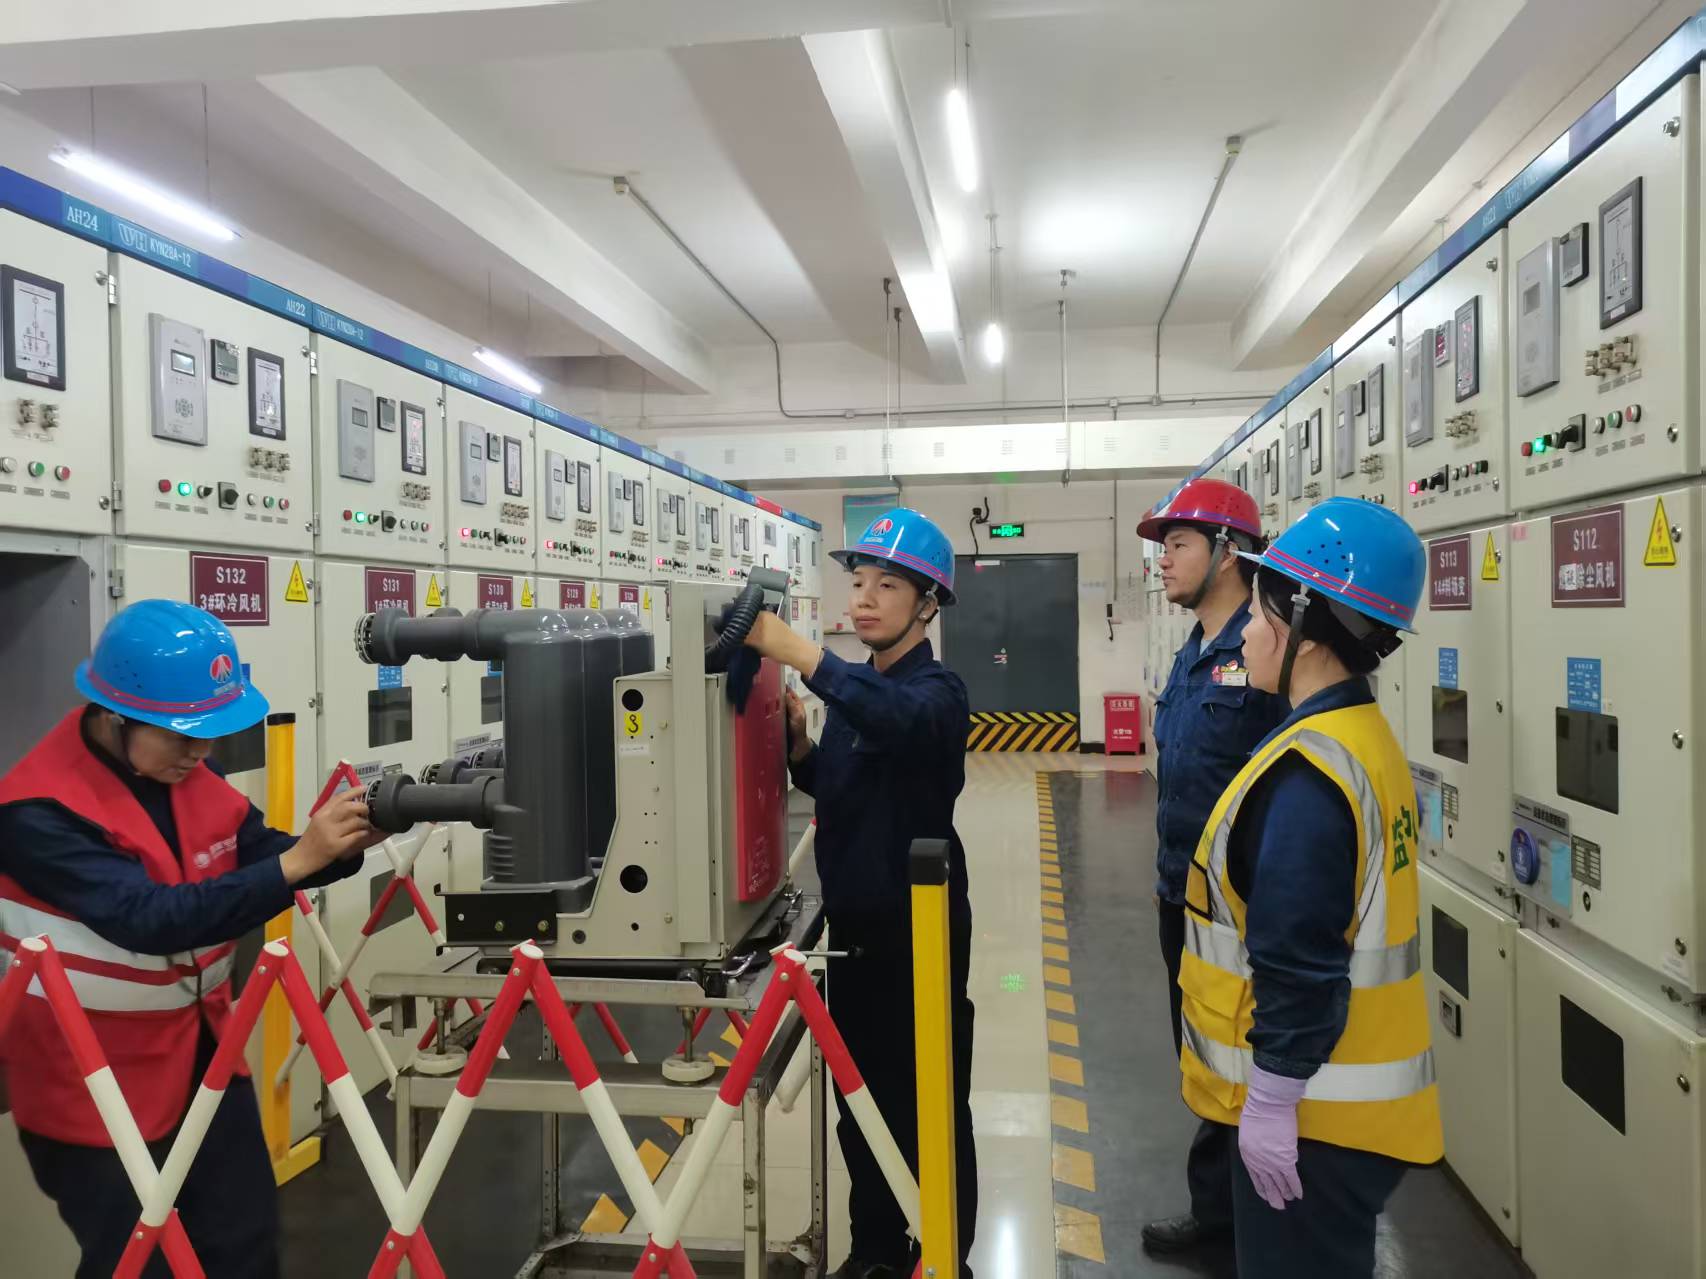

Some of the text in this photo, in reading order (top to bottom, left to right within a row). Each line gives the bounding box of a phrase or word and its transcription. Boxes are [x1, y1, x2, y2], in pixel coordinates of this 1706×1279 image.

[67, 205, 99, 232] AH24
[286, 299, 306, 317] AH22
[1573, 527, 1598, 552] S112
[1440, 550, 1457, 568] S113
[216, 566, 247, 585] S132
[382, 577, 400, 592] S131
[488, 583, 504, 596] S130
[200, 592, 262, 613] 3#环冷风机
